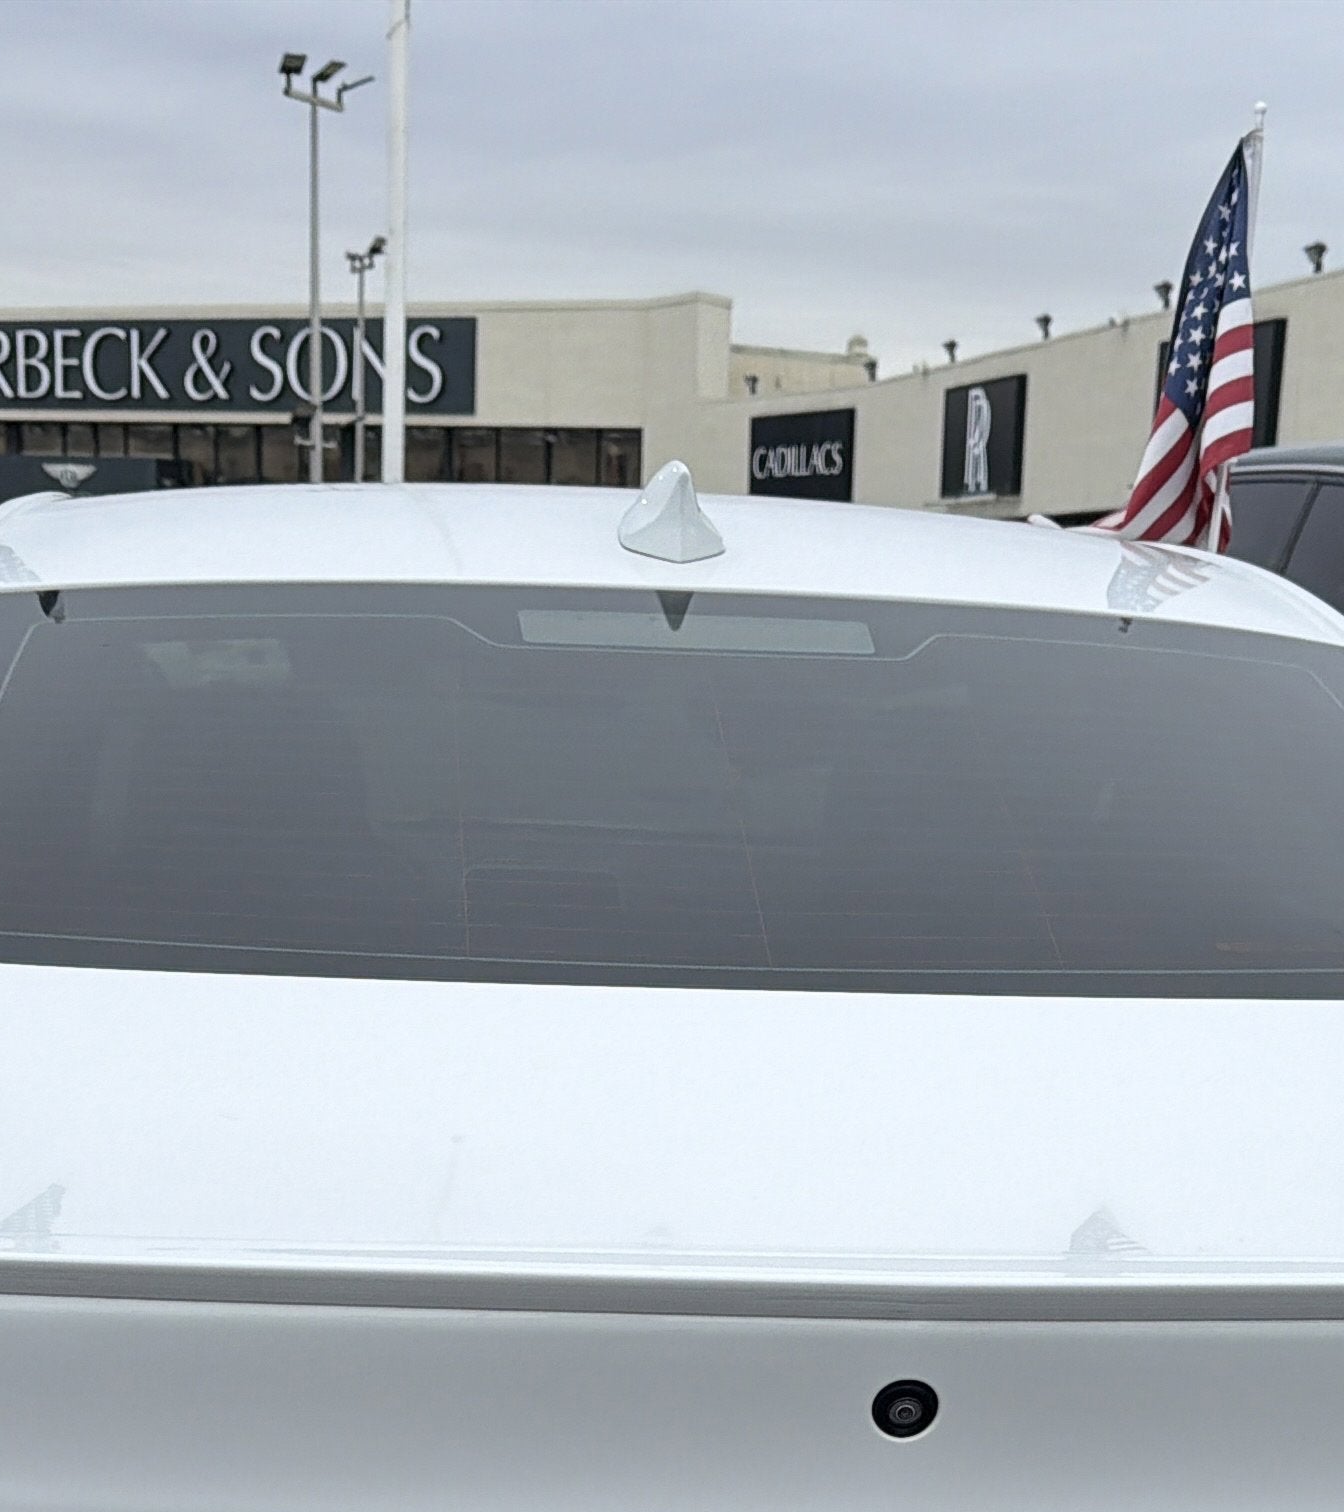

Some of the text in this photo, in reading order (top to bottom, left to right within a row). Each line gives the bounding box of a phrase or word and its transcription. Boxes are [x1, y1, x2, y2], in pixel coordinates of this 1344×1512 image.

[183, 328, 231, 401] &
[249, 325, 443, 404] SONS
[752, 440, 844, 480] CADILLACS
